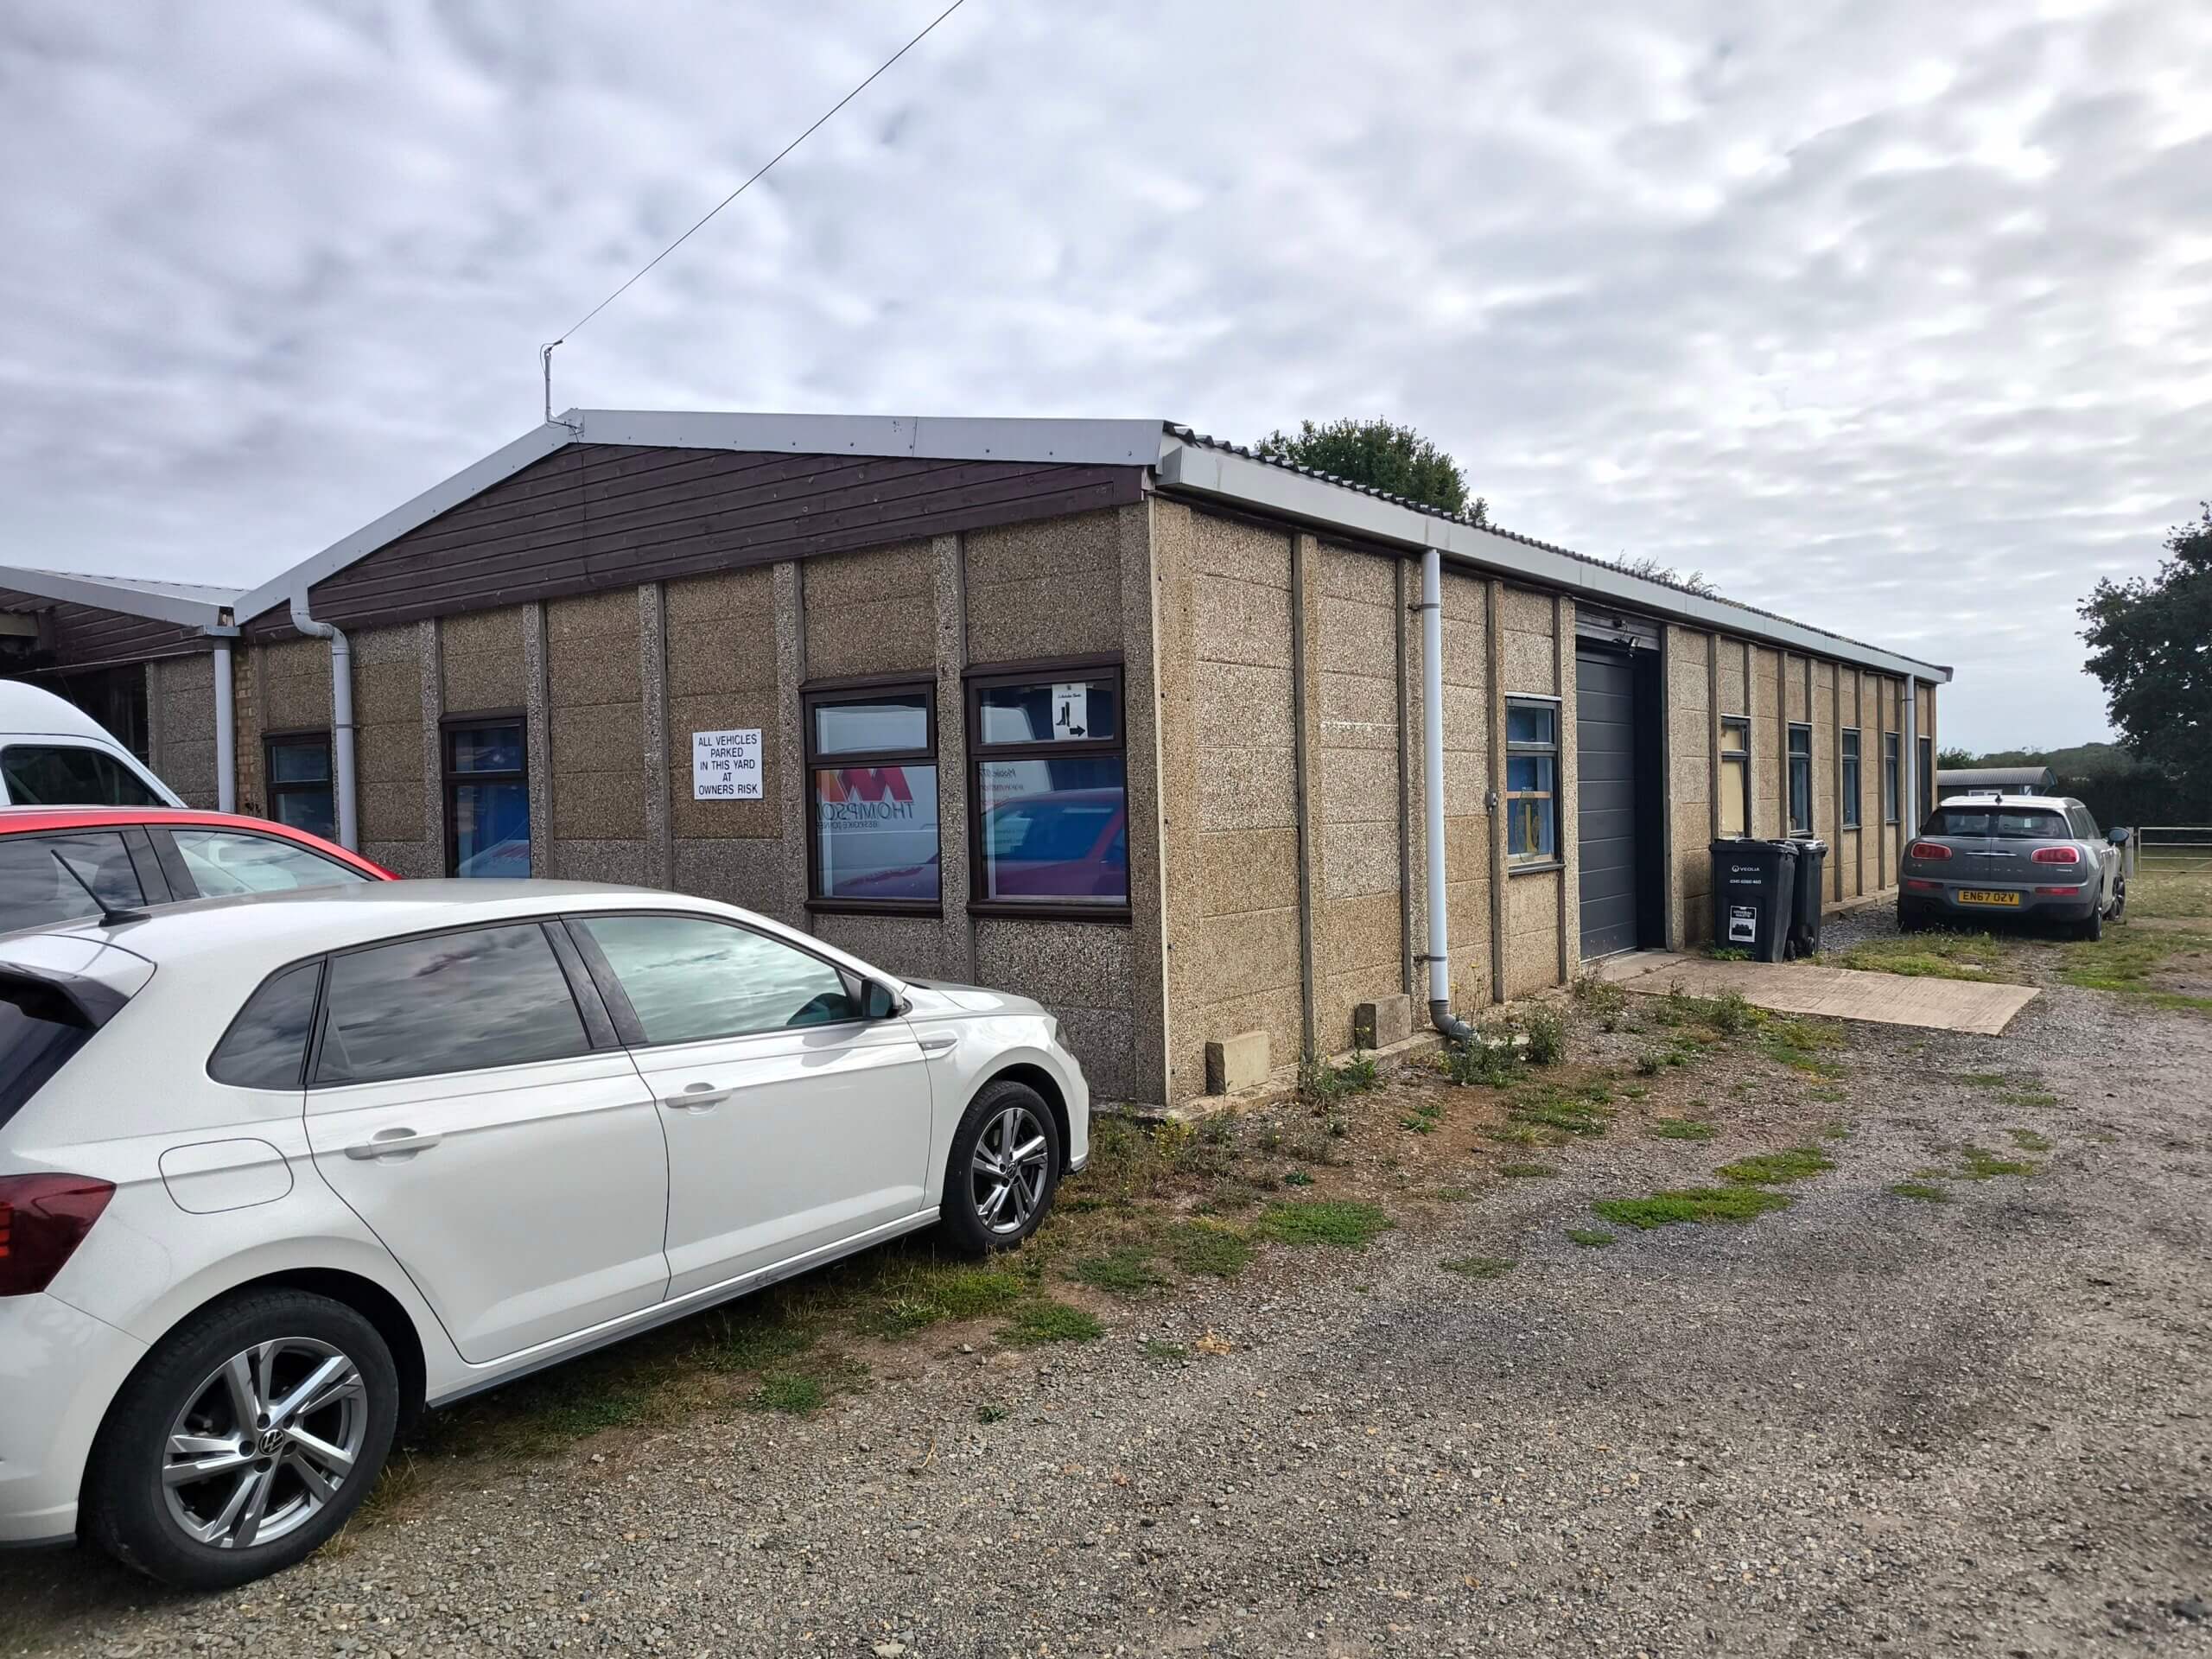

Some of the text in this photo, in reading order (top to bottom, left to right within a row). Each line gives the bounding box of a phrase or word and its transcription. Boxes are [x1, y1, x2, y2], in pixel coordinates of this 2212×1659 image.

[698, 734, 757, 747] ALL VEHICLES
[710, 747, 743, 758] PARKED
[700, 759, 755, 771] IN THIS YARD
[722, 772, 733, 781] AT
[698, 784, 758, 795] OWNERS RISK
[1963, 891, 2015, 902] EN67 OZV
